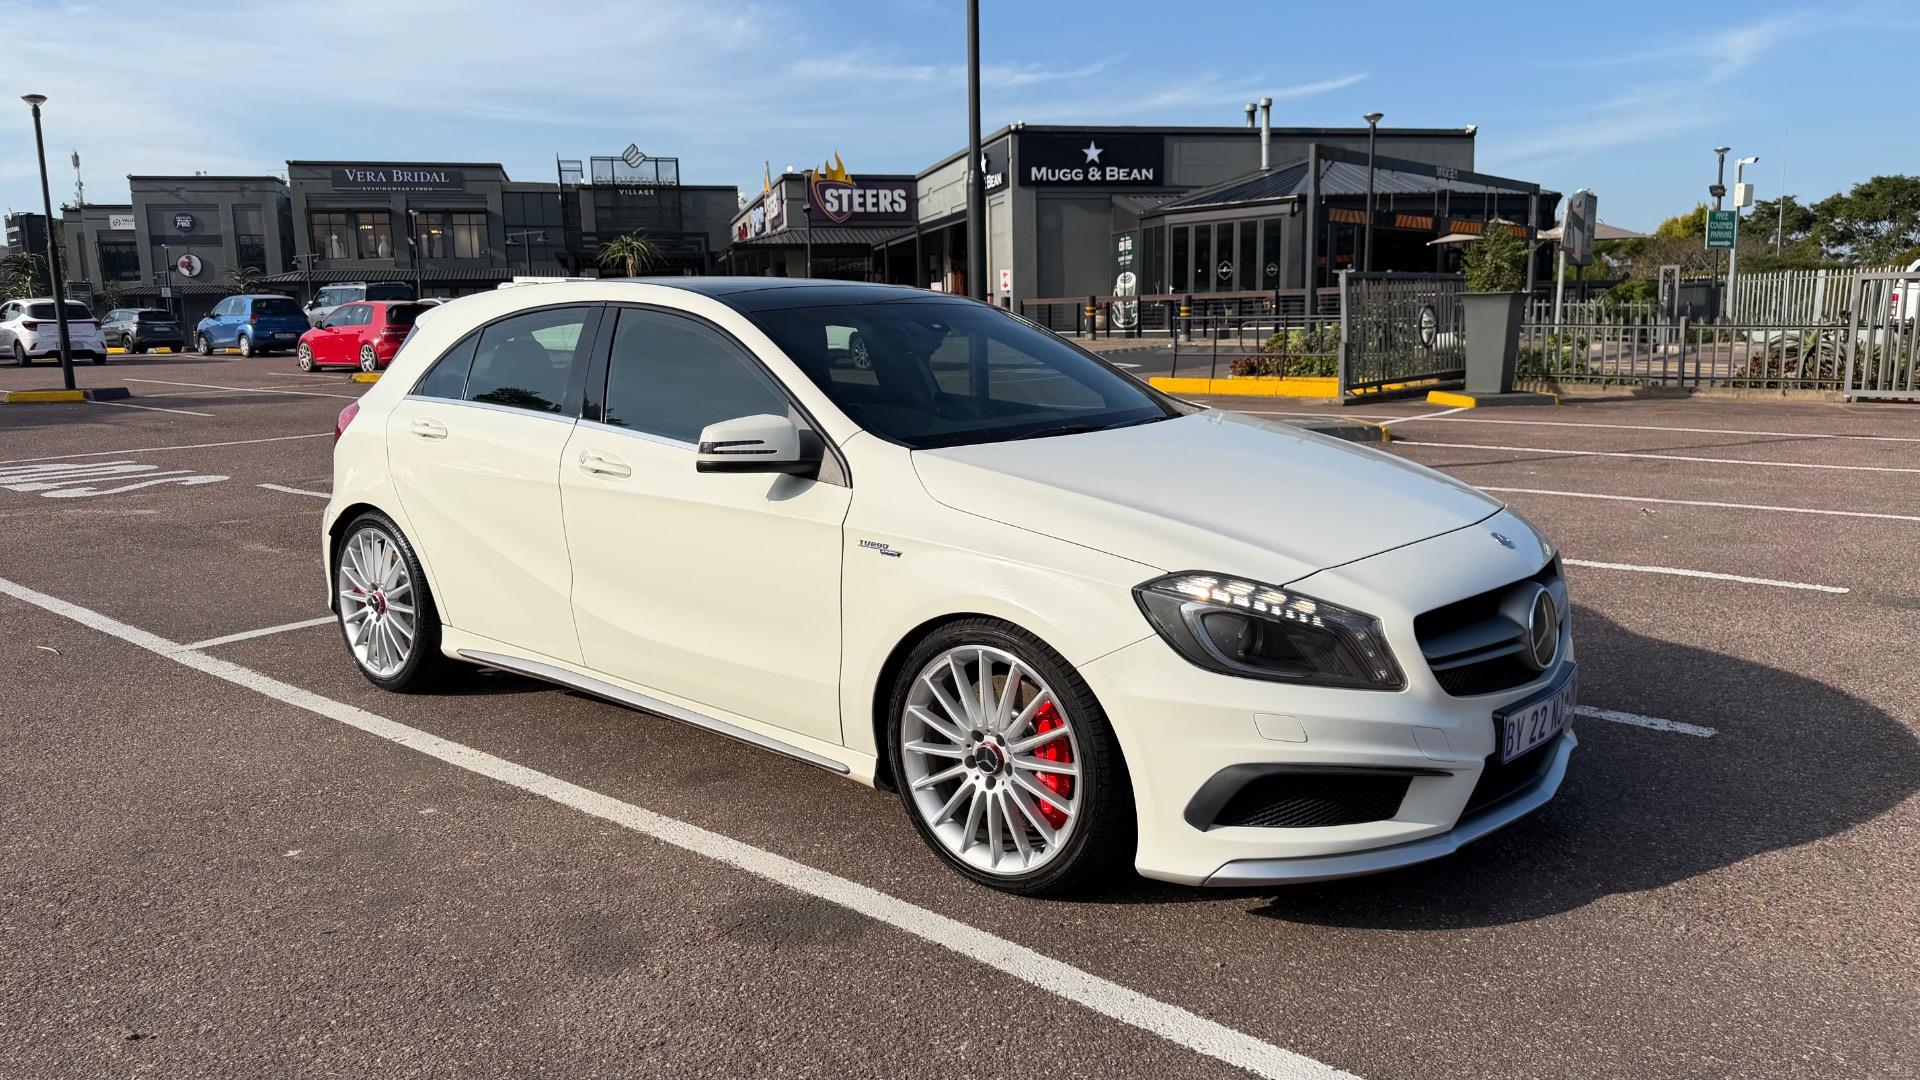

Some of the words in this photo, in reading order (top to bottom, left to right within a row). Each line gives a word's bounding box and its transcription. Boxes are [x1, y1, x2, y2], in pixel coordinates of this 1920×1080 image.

[345, 169, 387, 182] VERA
[392, 169, 449, 183] BRIDAL
[986, 172, 1002, 190] BEAN
[1031, 167, 1084, 182] MUGG
[1088, 167, 1102, 181] &
[1106, 167, 1154, 181] BEAN
[619, 188, 655, 196] VILLAGE
[824, 188, 907, 213] STEERS
[1716, 212, 1728, 220] FREE
[1506, 716, 1525, 756] BY
[1529, 705, 1547, 744] 22
